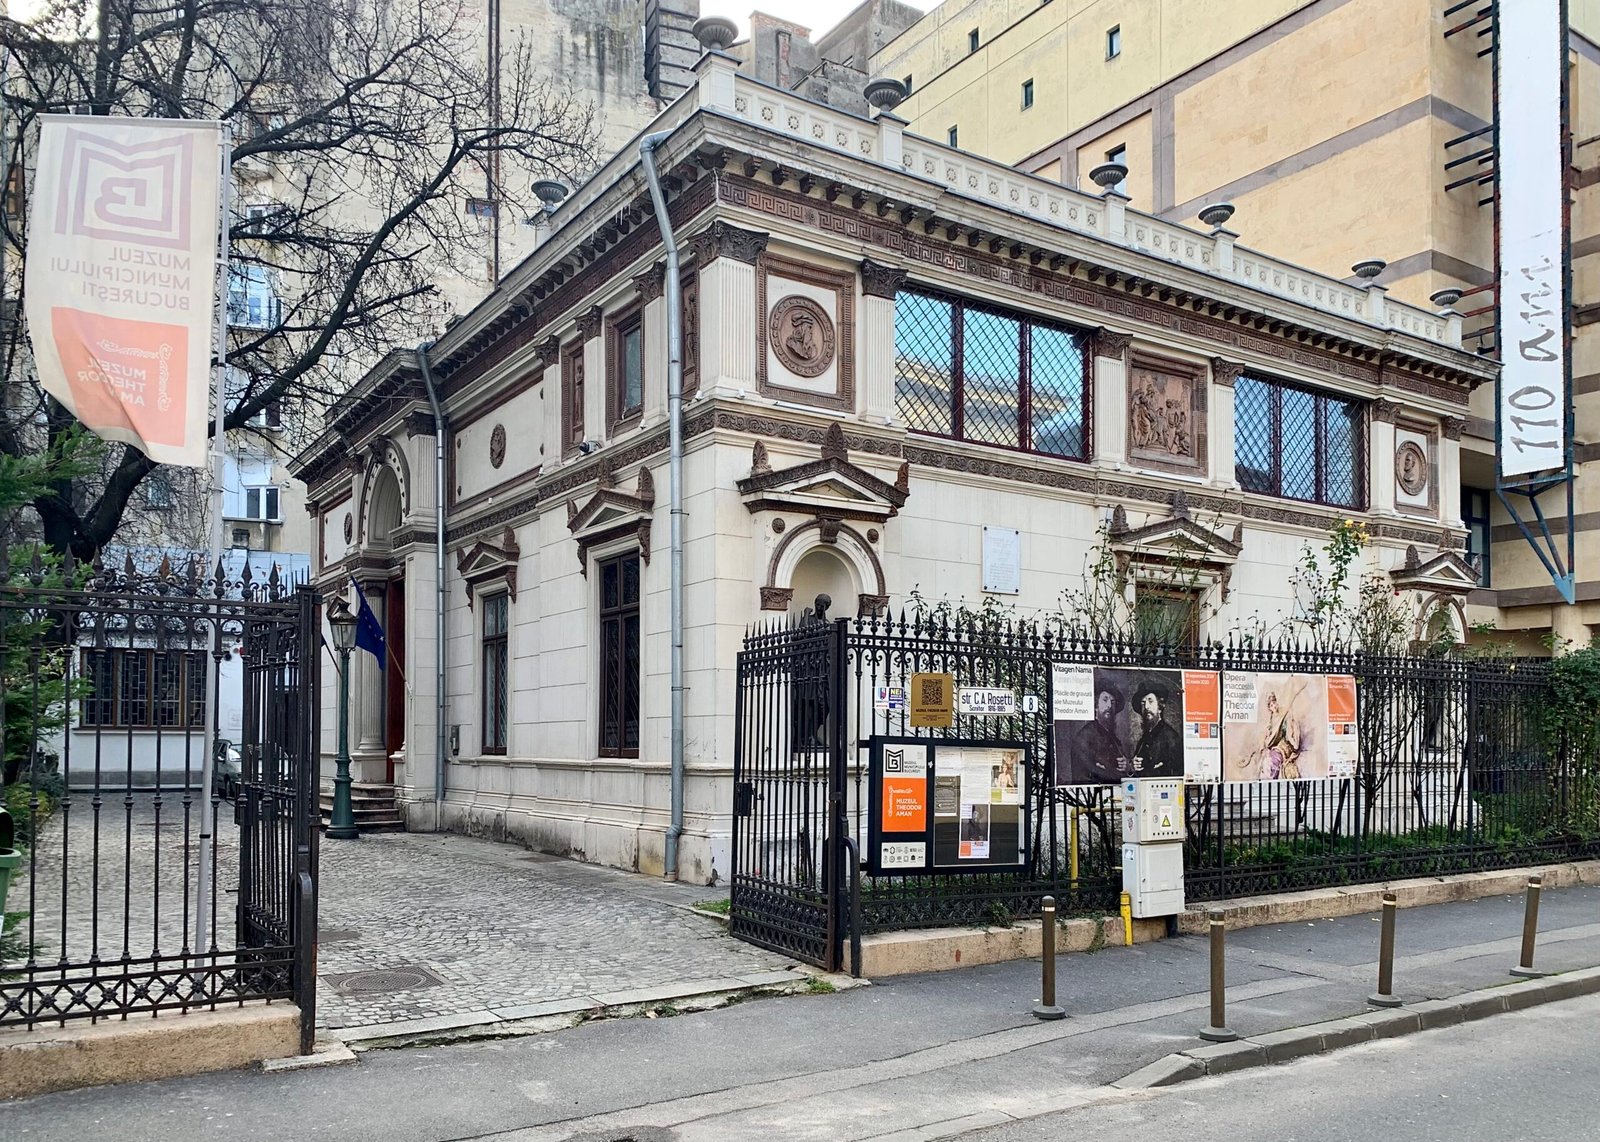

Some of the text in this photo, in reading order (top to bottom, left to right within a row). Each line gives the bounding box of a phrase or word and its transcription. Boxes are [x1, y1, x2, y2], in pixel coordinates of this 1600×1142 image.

[1508, 385, 1559, 453] 110
[1224, 673, 1246, 682] Opera
[987, 692, 1013, 706] Rosetti
[1028, 697, 1034, 711] 8
[1224, 700, 1255, 710] Theodor
[1224, 710, 1249, 720] Aman
